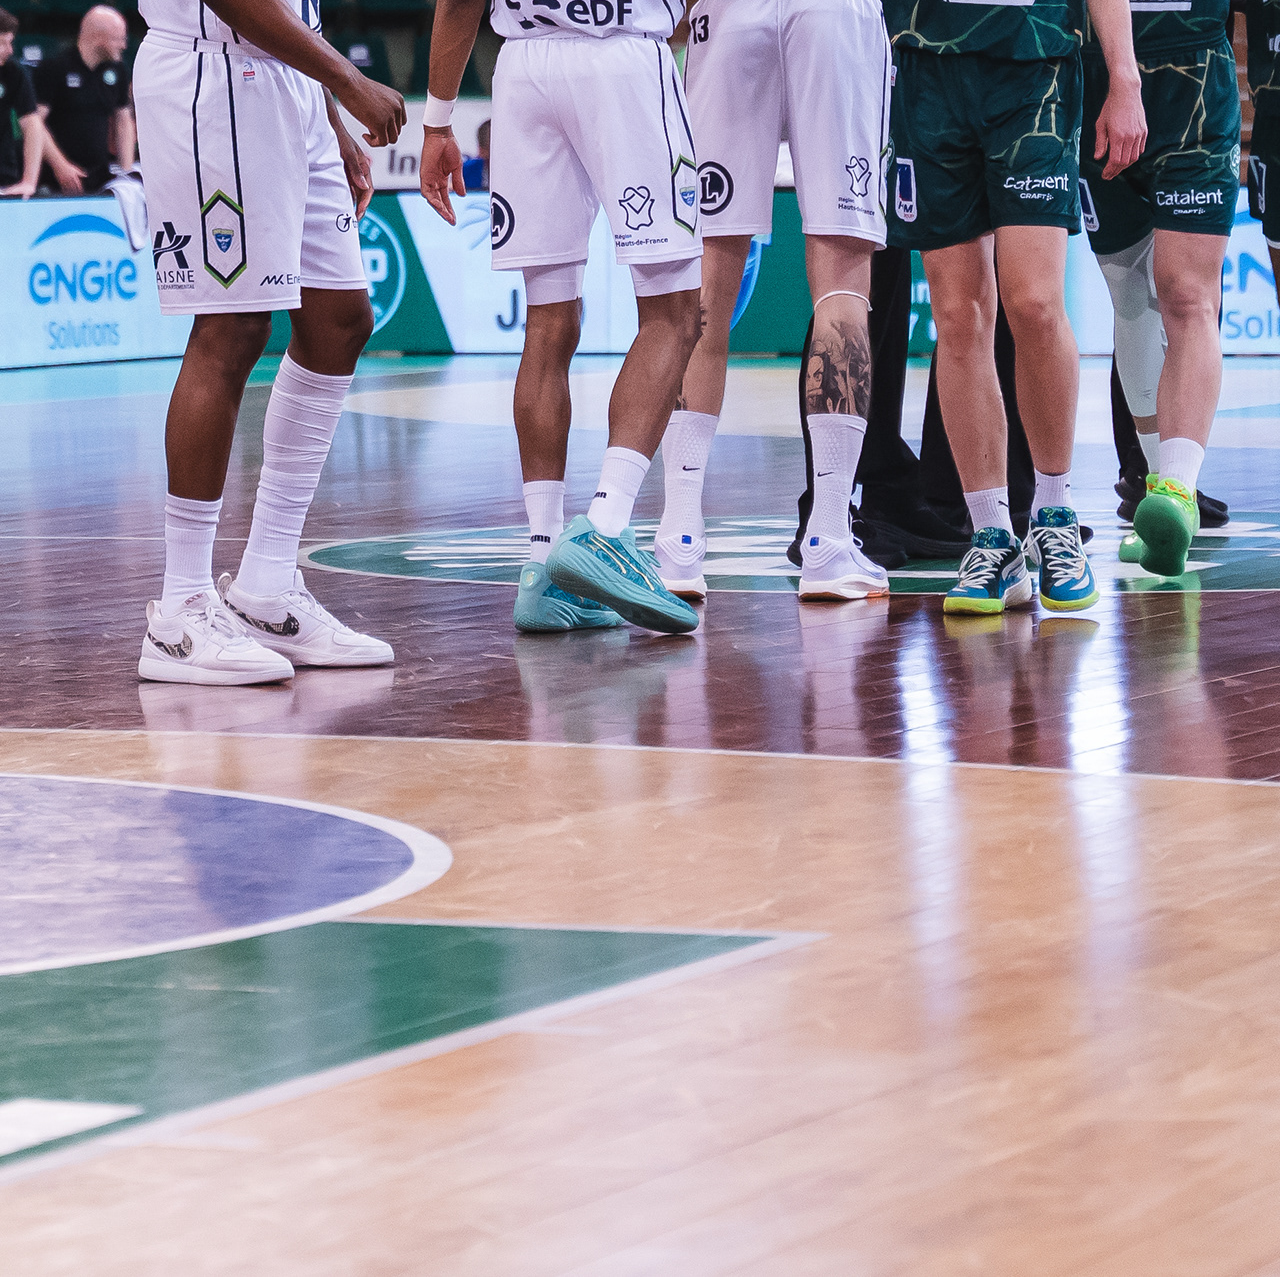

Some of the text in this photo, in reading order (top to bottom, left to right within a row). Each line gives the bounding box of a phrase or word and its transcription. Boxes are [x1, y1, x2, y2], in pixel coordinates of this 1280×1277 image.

[690, 13, 710, 45] 13
[1155, 188, 1224, 207] Catalent
[615, 237, 669, 248] Hauts-de-France
[48, 320, 121, 350] Solutions
